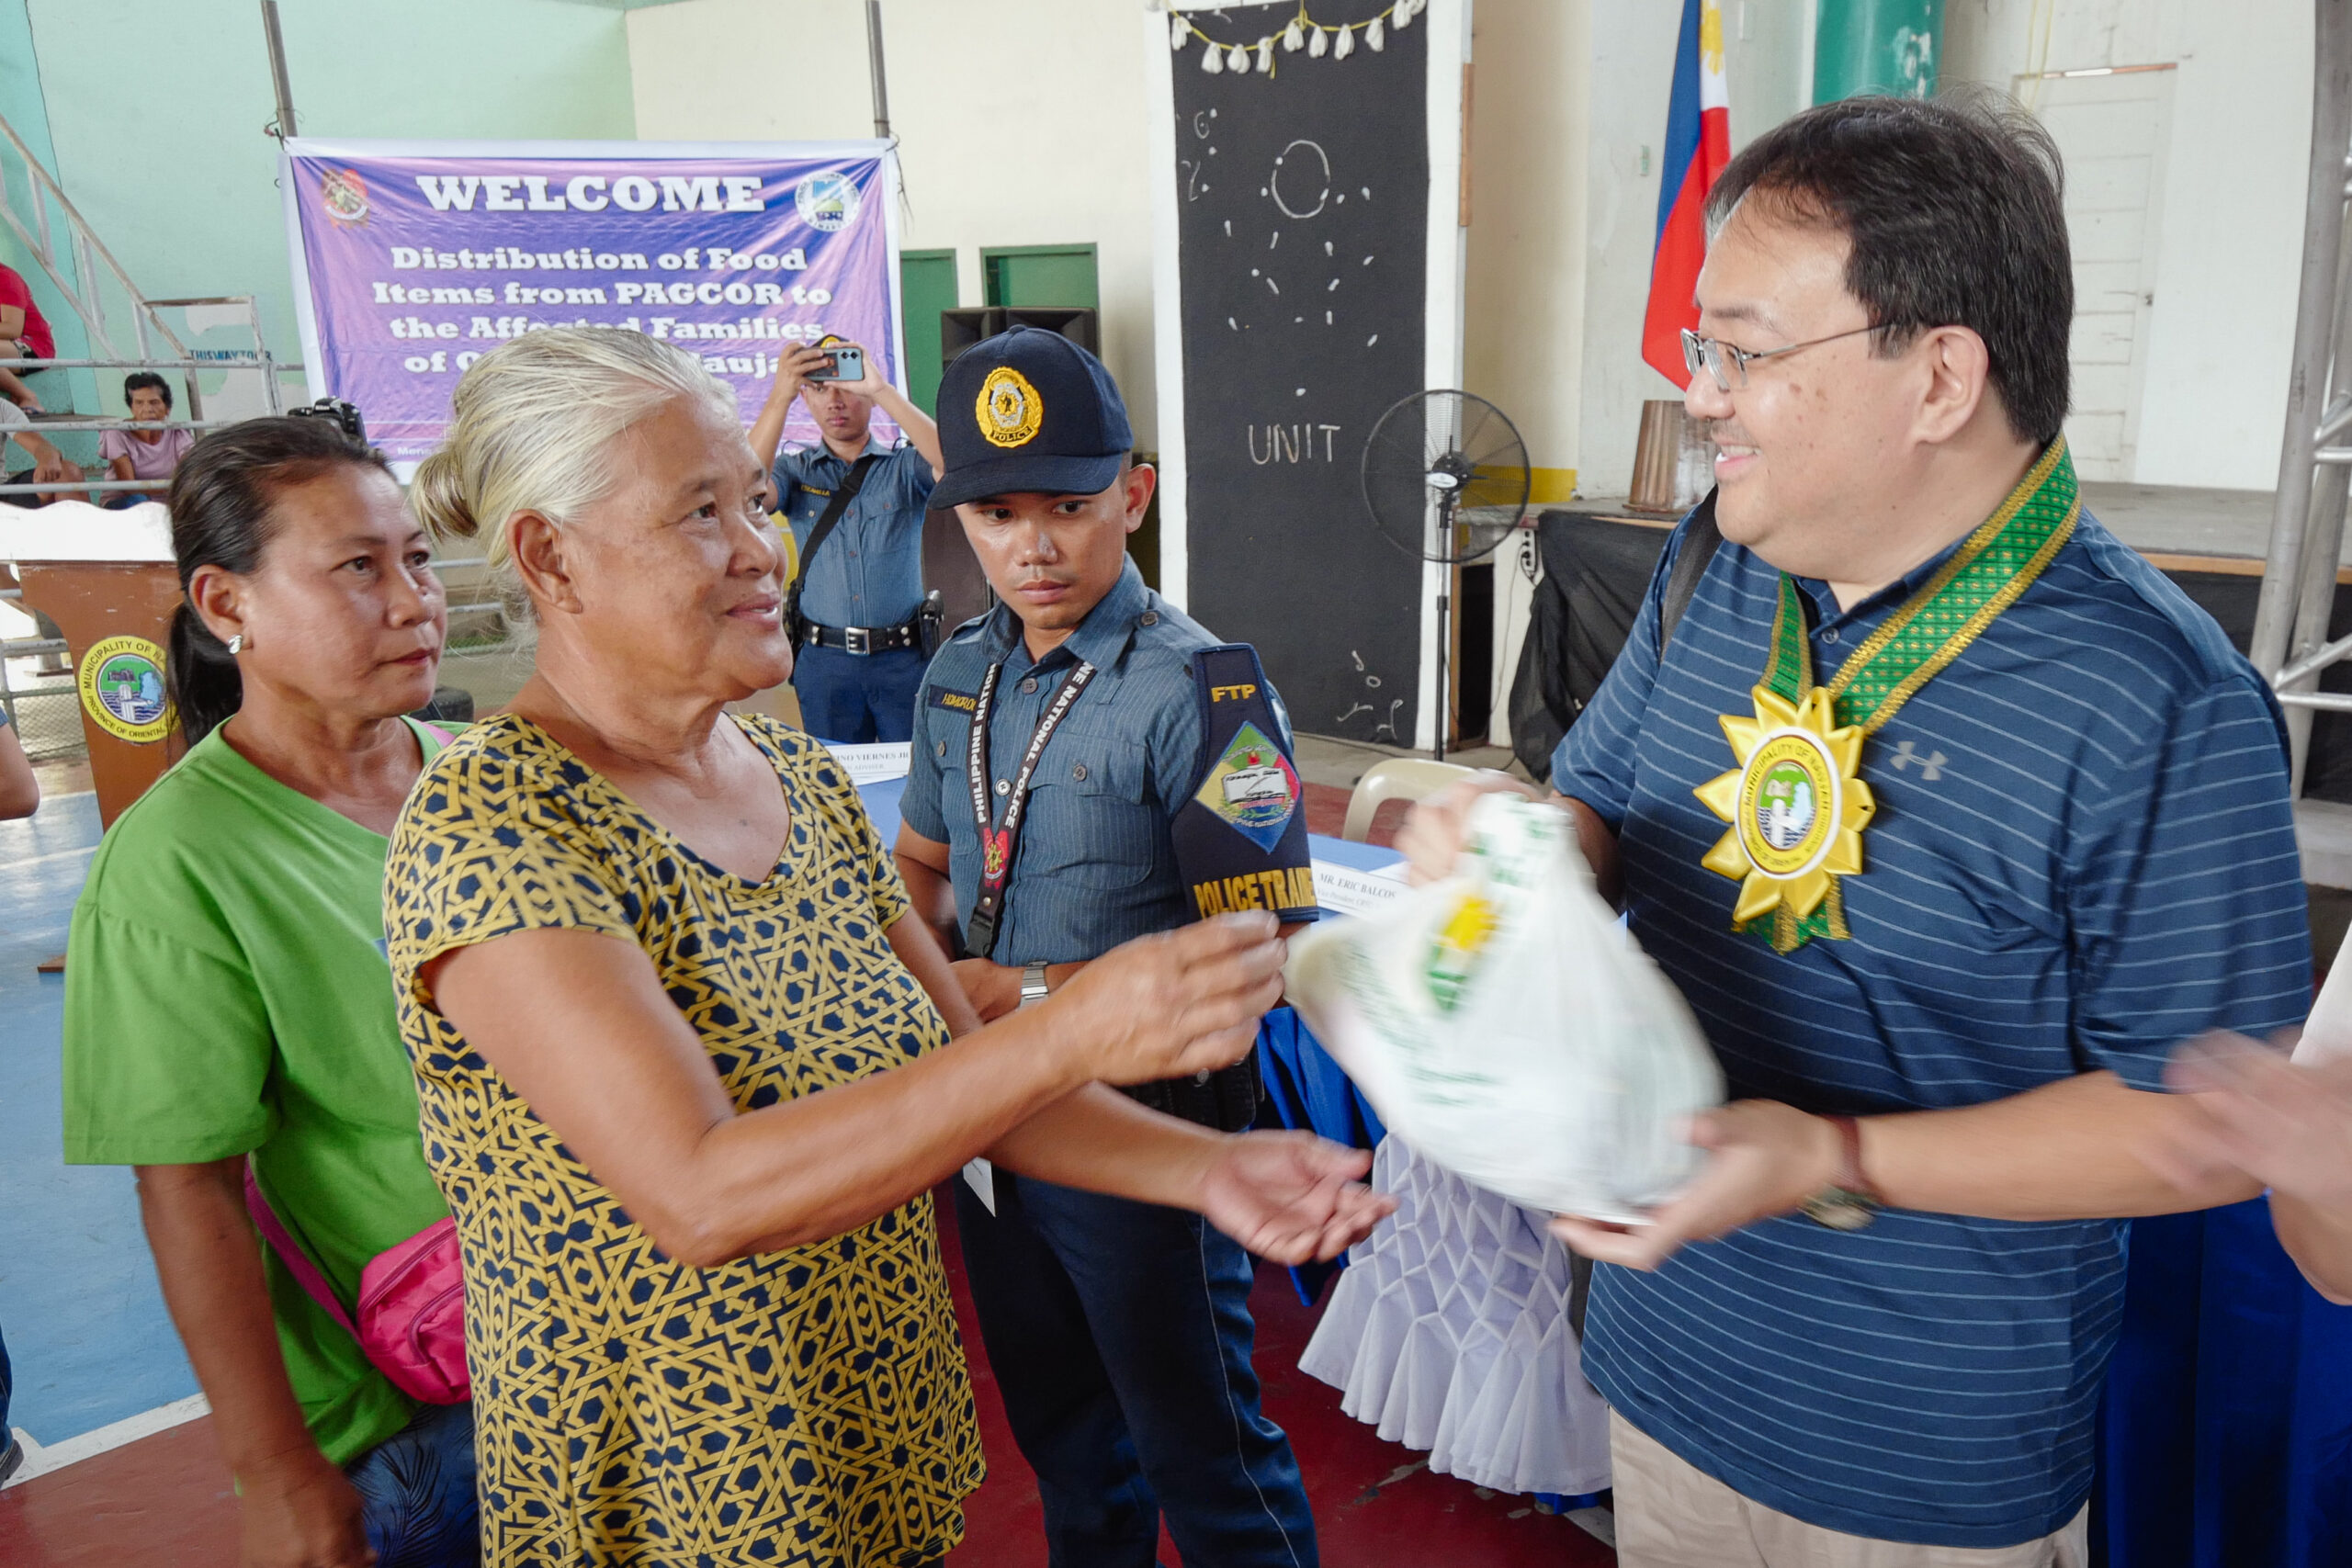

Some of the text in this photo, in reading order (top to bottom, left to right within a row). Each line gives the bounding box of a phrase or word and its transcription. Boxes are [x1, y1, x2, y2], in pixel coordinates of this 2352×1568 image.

[415, 175, 765, 212] WELCOME
[390, 247, 808, 270] Distribution of Food
[372, 282, 832, 305] Items from PAGCOR to
[390, 317, 459, 339] the
[650, 317, 824, 339] Families
[404, 351, 447, 373] of
[993, 426, 1031, 442] POLICE
[1249, 423, 1340, 465] UNIT
[84, 641, 131, 689] MUNICIPALITY
[136, 642, 152, 653] OF
[1211, 684, 1256, 703] FTP
[87, 695, 116, 729] PROVINCE
[1025, 685, 1078, 761] NATIONAL
[971, 724, 987, 824] PHILIPPINE
[1005, 766, 1031, 829] POLICE
[1337, 877, 1361, 891] ERIC
